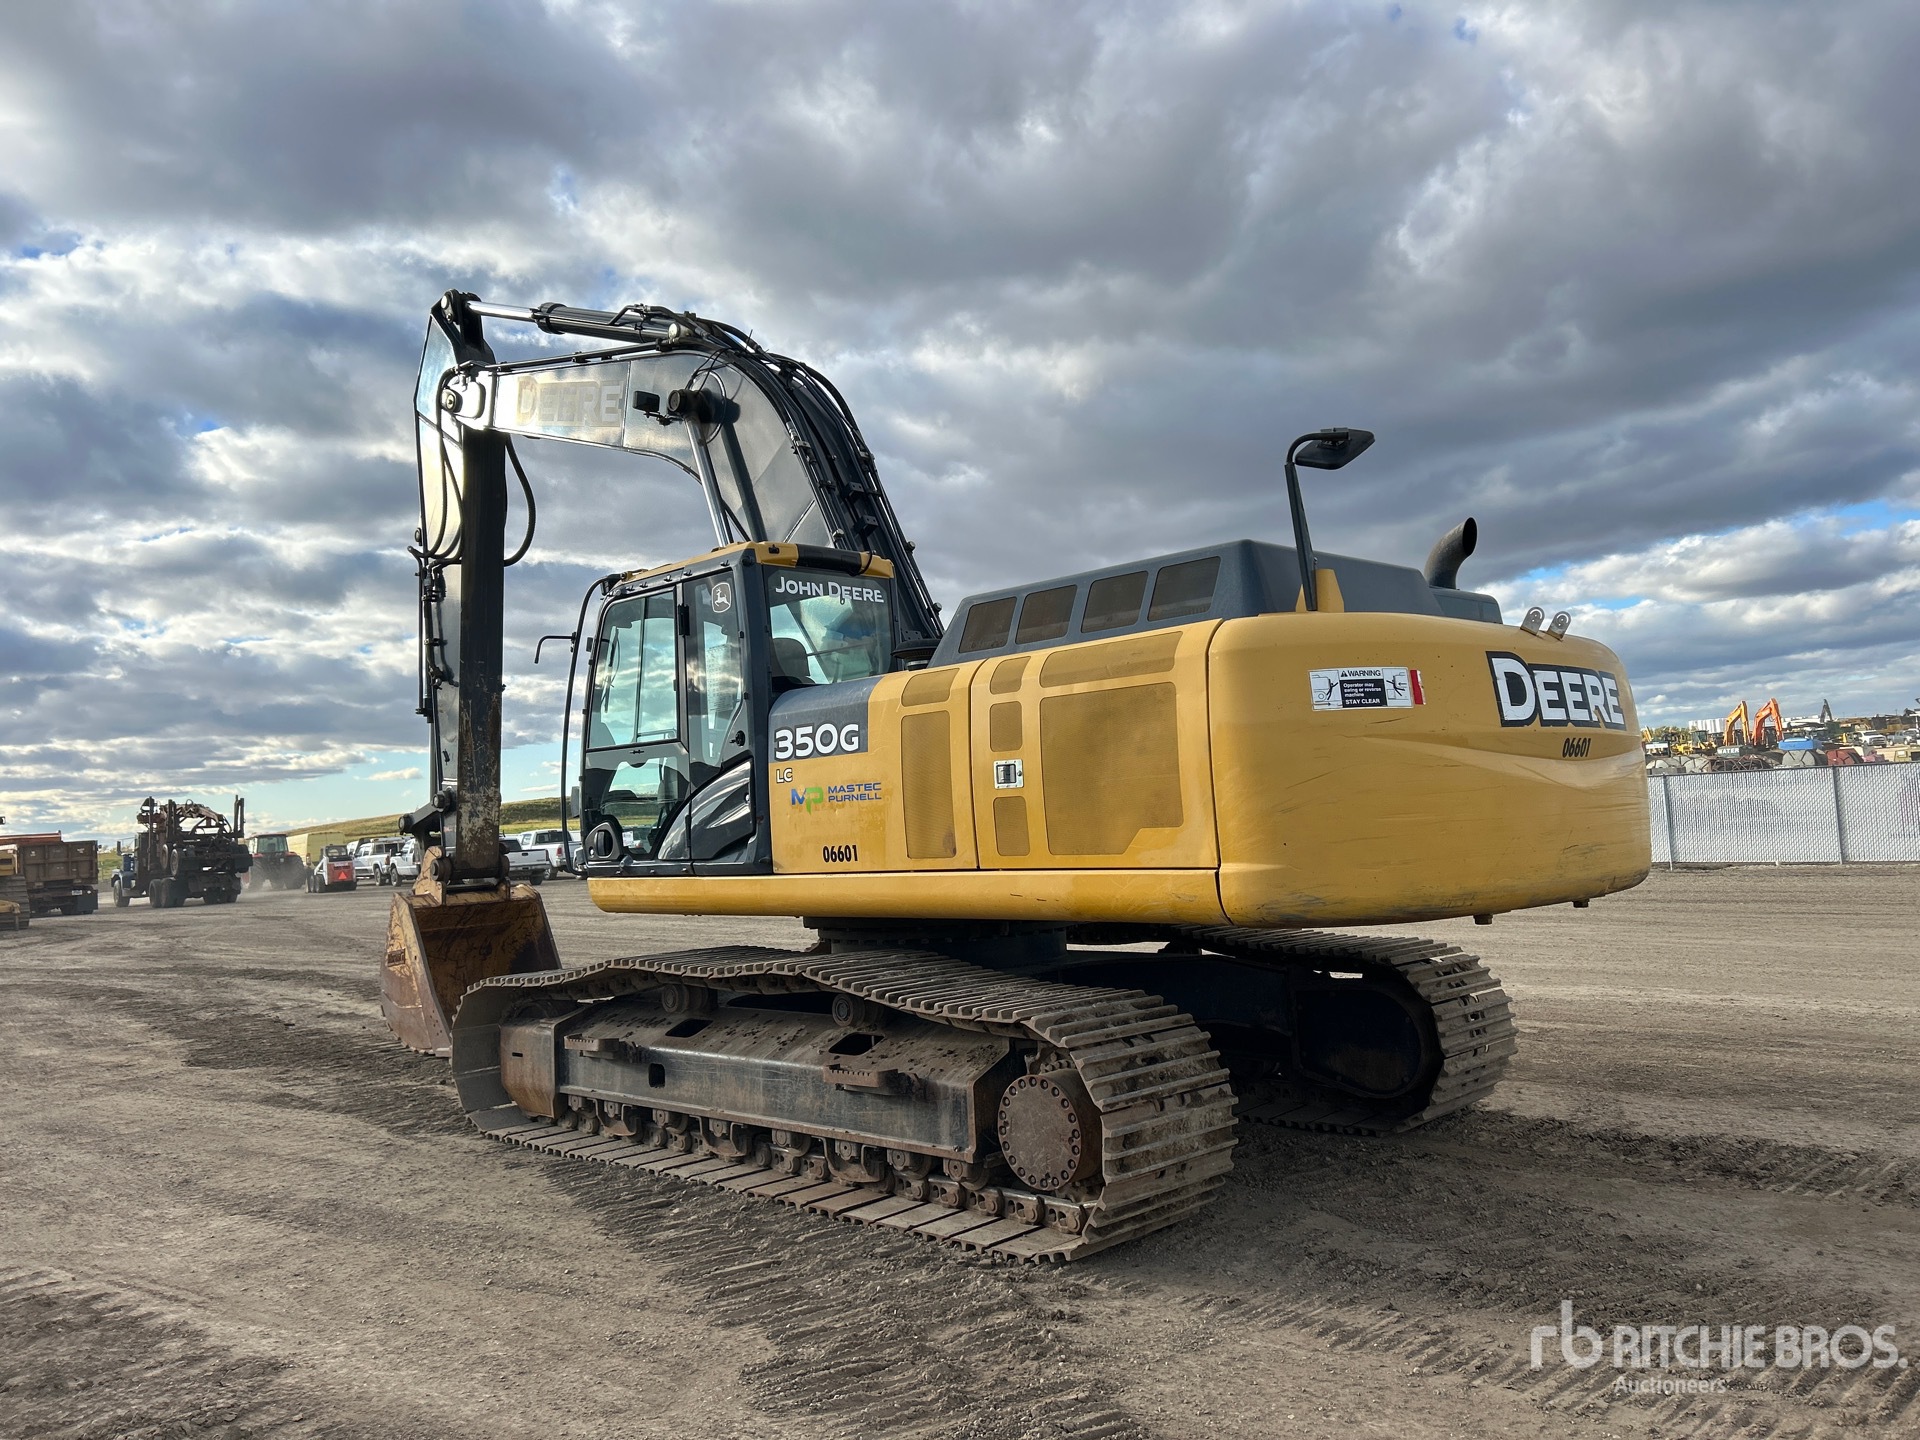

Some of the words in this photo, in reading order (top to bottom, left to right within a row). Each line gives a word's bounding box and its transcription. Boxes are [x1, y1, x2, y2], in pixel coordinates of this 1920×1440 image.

[519, 378, 621, 424] DEERE
[775, 577, 824, 597] JOHN
[827, 581, 885, 603] DEERE
[1491, 657, 1625, 725] DEERE
[775, 723, 859, 760] 350G
[1562, 737, 1592, 758] 06601
[776, 768, 793, 783] LC
[828, 782, 882, 794] MASTEC
[828, 792, 882, 803] PURNELL
[823, 845, 858, 863] 06601
